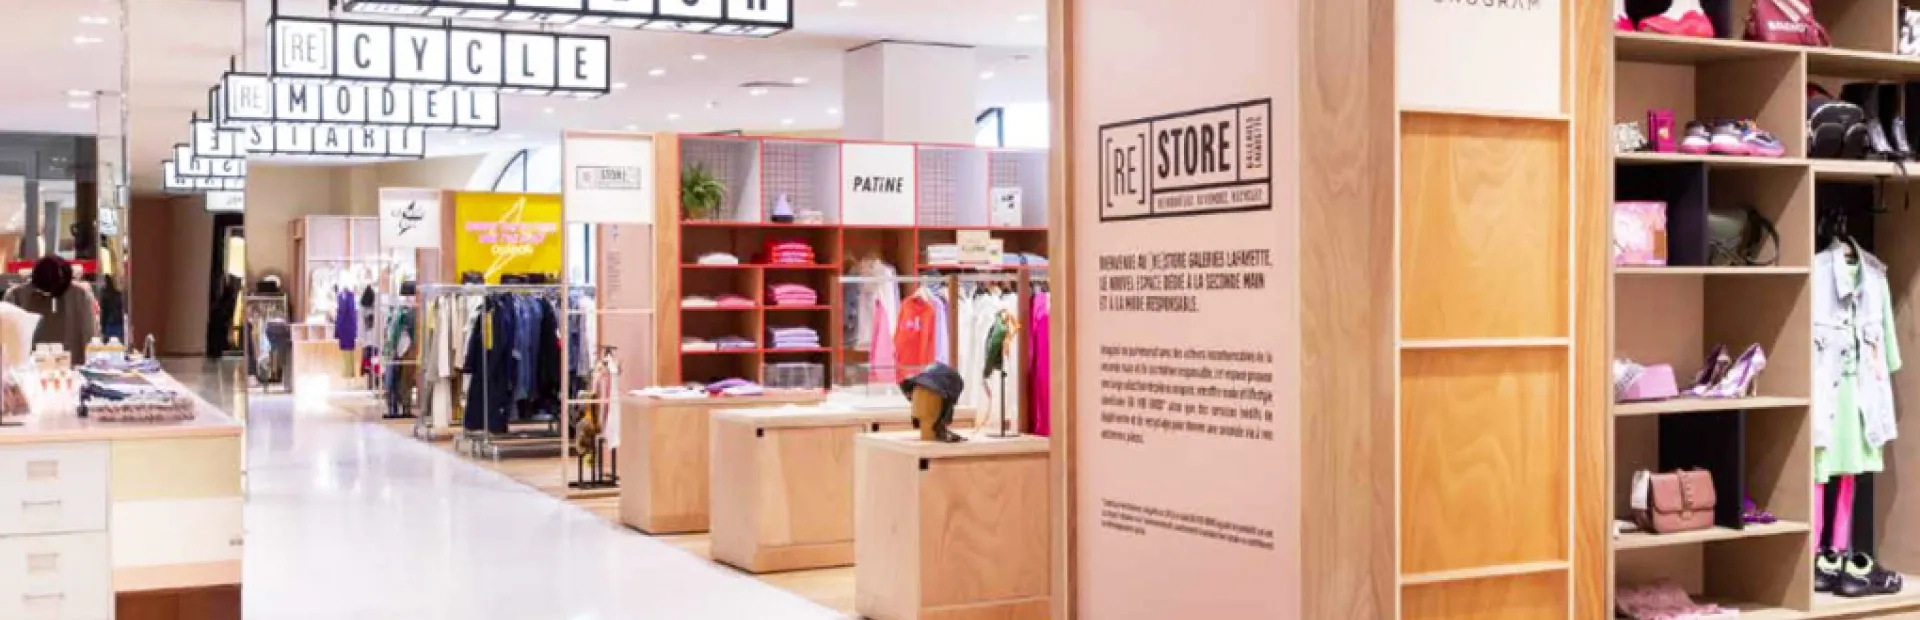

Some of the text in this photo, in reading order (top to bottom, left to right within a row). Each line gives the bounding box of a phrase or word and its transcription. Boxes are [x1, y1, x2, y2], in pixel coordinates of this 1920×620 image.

[281, 26, 588, 80] [RE] CYCLE
[288, 84, 481, 120] MODEL
[1105, 120, 1231, 208] [RE] STORE
